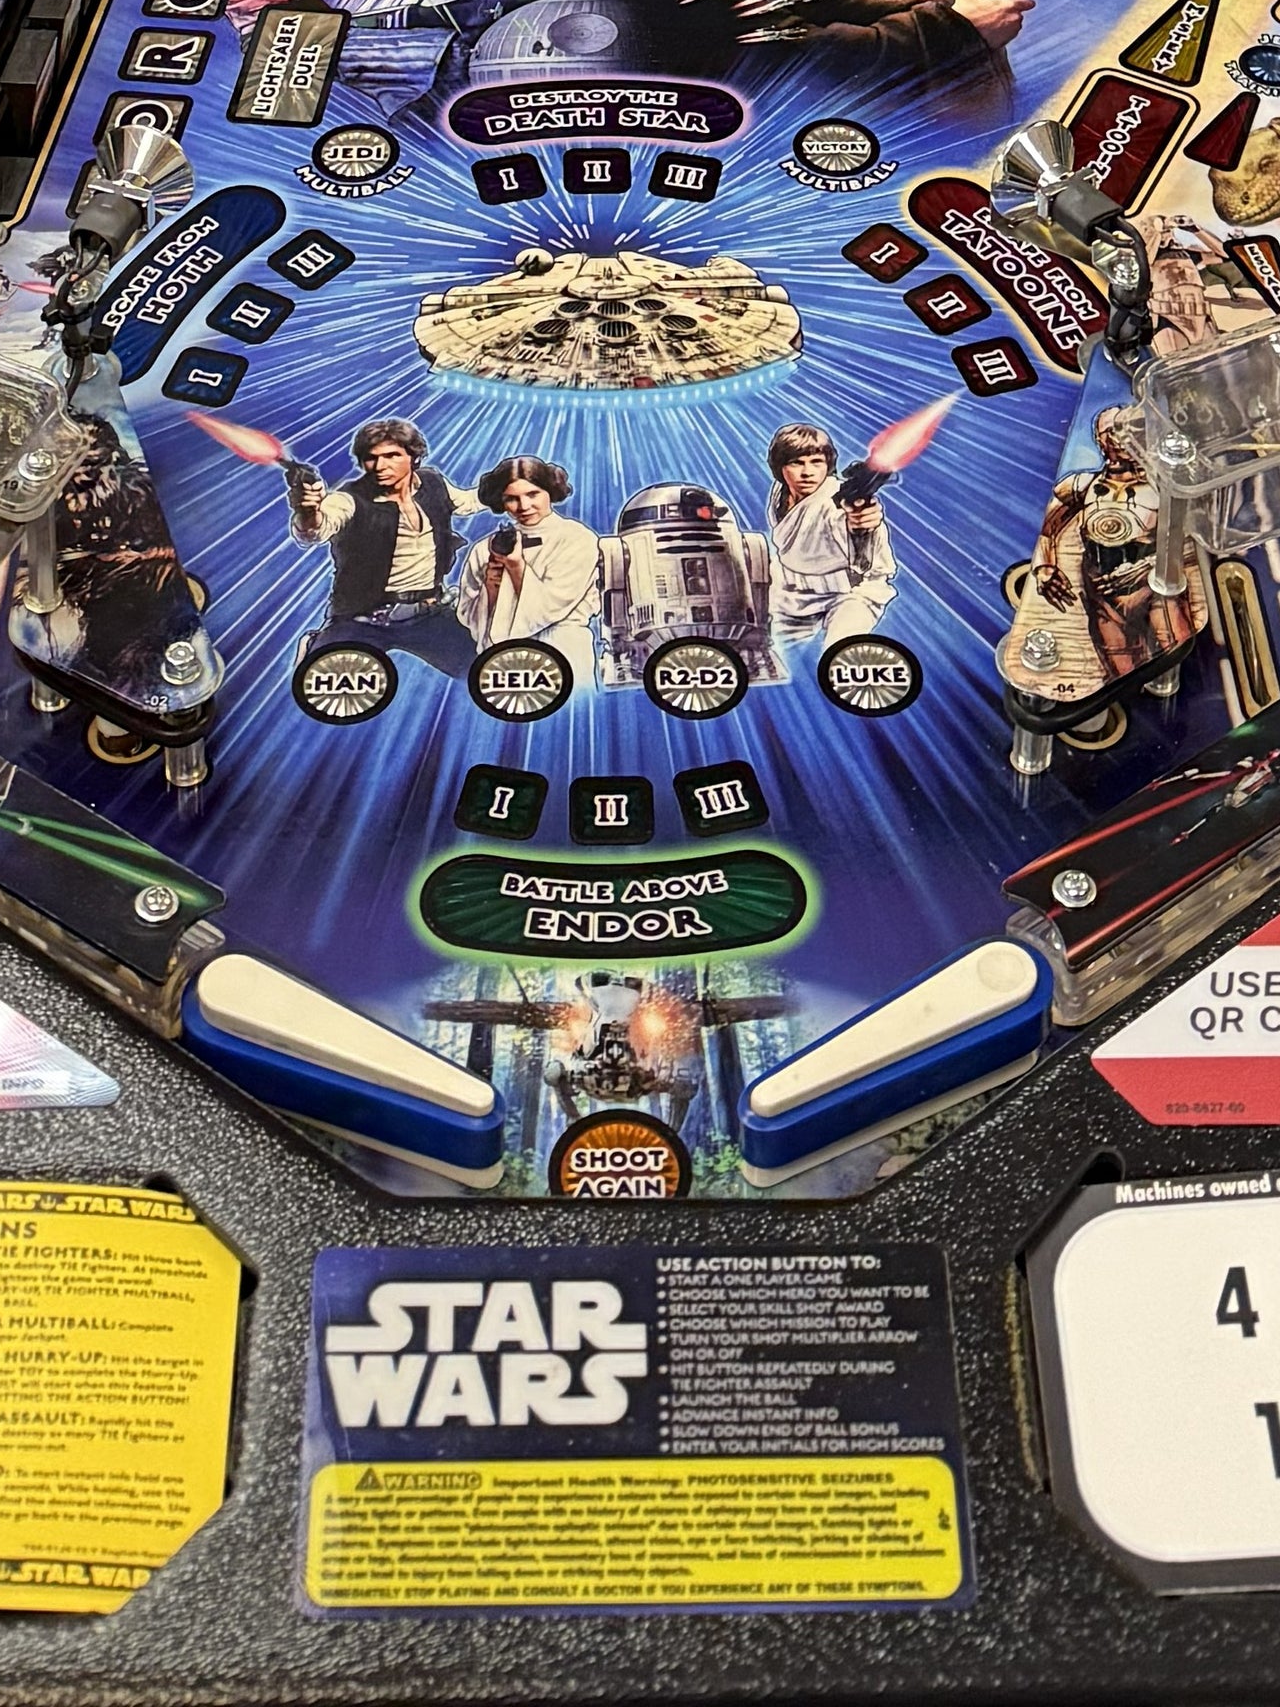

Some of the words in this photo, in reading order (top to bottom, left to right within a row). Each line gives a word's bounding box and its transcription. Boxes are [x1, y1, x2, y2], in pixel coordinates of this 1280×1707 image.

[251, 14, 303, 116] LIGHTSABER
[290, 44, 321, 90] DUEL
[510, 90, 624, 108] DESTROY
[627, 90, 678, 106] THE
[484, 107, 605, 136] DEATH
[619, 108, 710, 134] STAR
[322, 144, 389, 162] JEDI
[802, 141, 871, 155] VICTORY
[293, 163, 416, 198] MULTIBALL
[583, 160, 611, 183] II
[664, 164, 707, 189] III
[780, 159, 899, 192] MULTIBALL
[102, 265, 162, 330] SCAPE
[153, 216, 220, 266] FROM
[287, 243, 335, 277] III
[137, 245, 224, 325] HOTH
[940, 208, 1087, 349] TATOOINE
[1044, 267, 1100, 321] FROM
[973, 349, 1017, 385] III
[311, 669, 378, 695] HAN
[489, 669, 554, 691] LEIA
[659, 667, 734, 687] R2-D2
[833, 664, 908, 687] LUKE
[594, 795, 627, 827] II
[695, 781, 750, 818] III
[501, 874, 614, 904] BATTLE
[624, 870, 728, 902] ABOVE
[524, 908, 712, 943] ENDOR
[1190, 1007, 1244, 1040] QR
[571, 1148, 668, 1172] SHOOT
[573, 1176, 666, 1198] AGAIN
[1115, 1179, 1204, 1204] Machines
[1209, 1175, 1271, 1196] owned
[656, 1257, 692, 1271] USE
[695, 1257, 768, 1271] ACTION
[772, 1256, 847, 1270] BUTTON
[850, 1256, 882, 1269] TO:
[325, 1281, 647, 1352] STAR
[1216, 1266, 1260, 1339] 4
[325, 1352, 647, 1428] WARS
